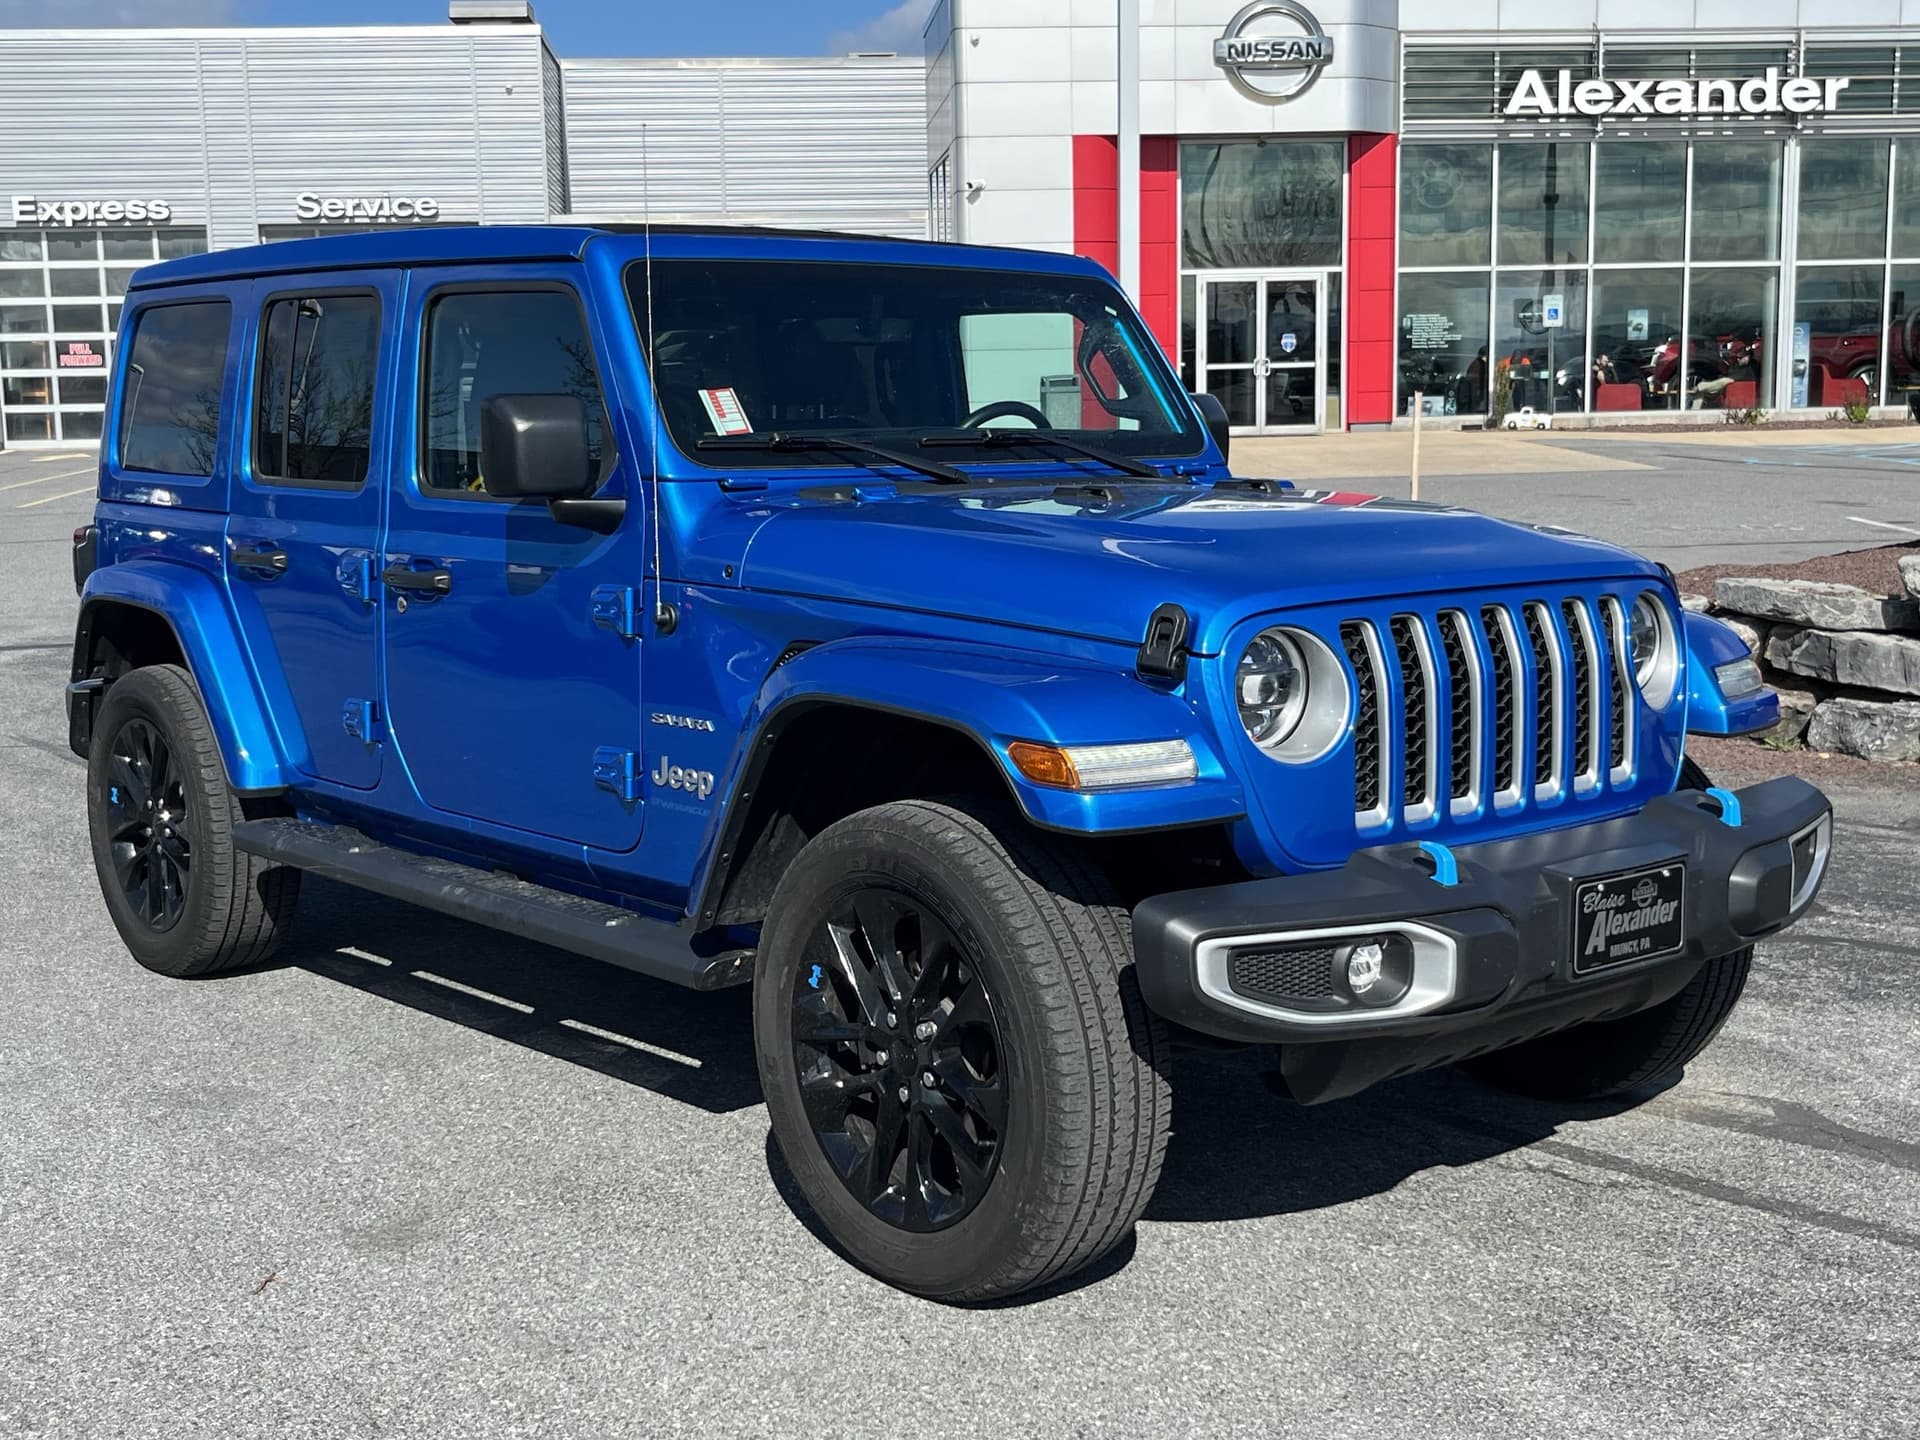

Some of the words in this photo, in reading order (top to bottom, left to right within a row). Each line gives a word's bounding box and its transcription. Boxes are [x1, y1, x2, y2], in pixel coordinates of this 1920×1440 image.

[1227, 41, 1323, 60] NISSAN
[1504, 67, 1849, 114] Alexander
[11, 195, 171, 227] Express
[296, 191, 438, 219] Service
[60, 354, 102, 366] FORWARD
[651, 712, 715, 732] SAHARA
[651, 755, 714, 800] Jeep
[1583, 892, 1625, 914] Blaise
[1584, 898, 1679, 955] Alexander
[1610, 939, 1639, 957] MUNCY,
[1640, 937, 1651, 951] PA
